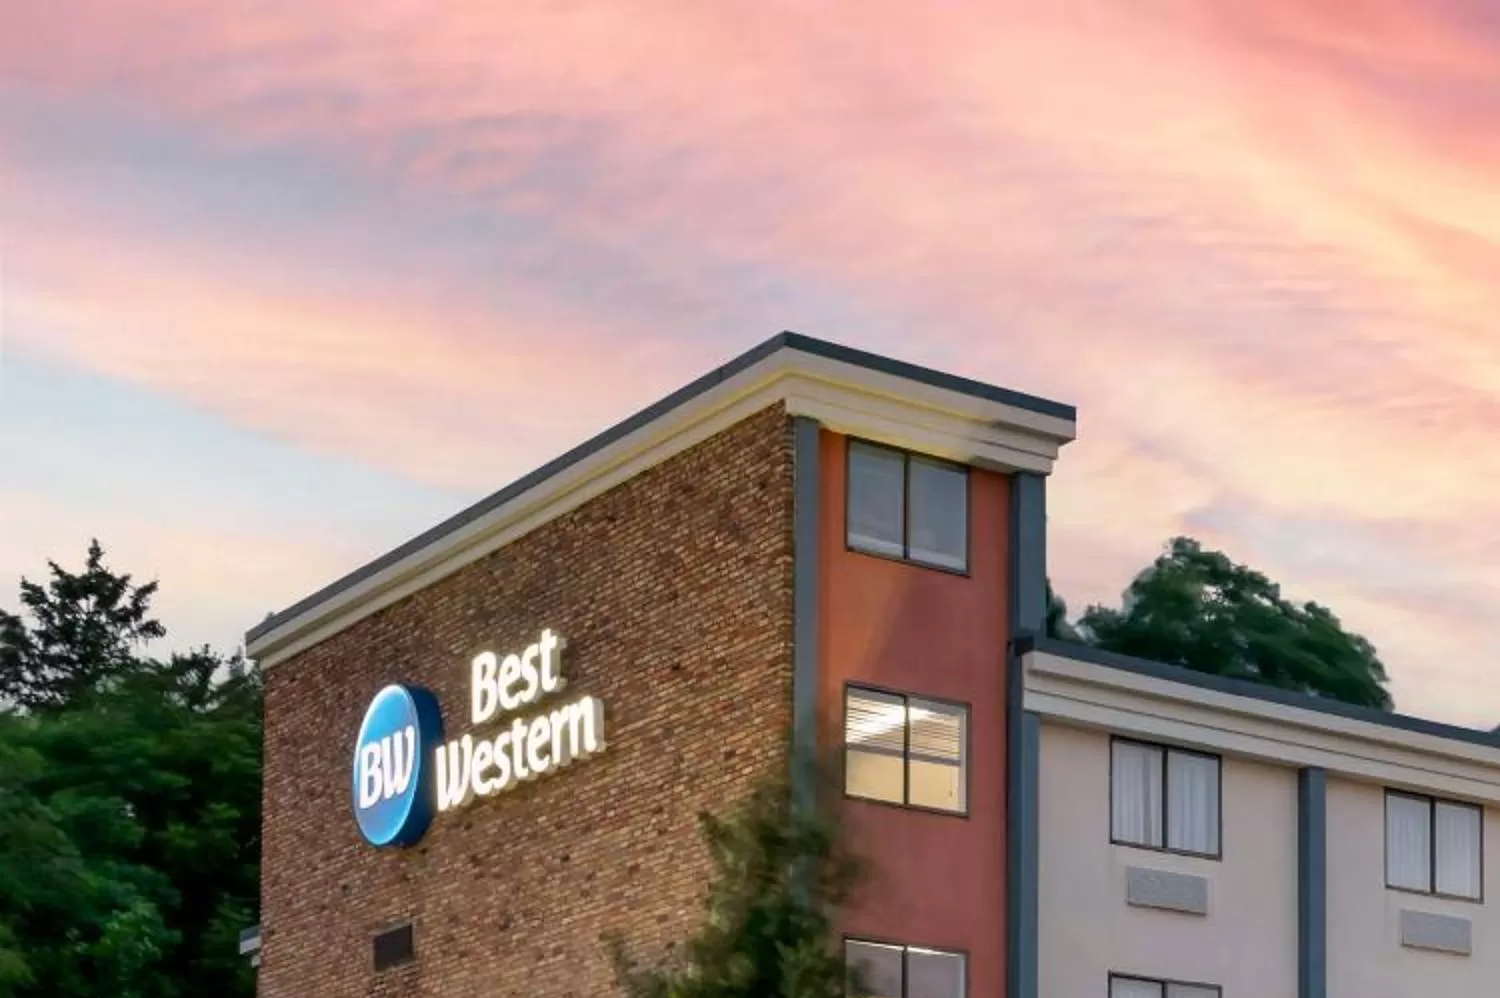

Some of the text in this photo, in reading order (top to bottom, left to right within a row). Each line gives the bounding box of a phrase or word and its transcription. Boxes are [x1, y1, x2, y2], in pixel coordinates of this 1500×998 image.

[471, 628, 562, 724] Best
[359, 726, 415, 809] BW
[435, 695, 603, 812] Western
